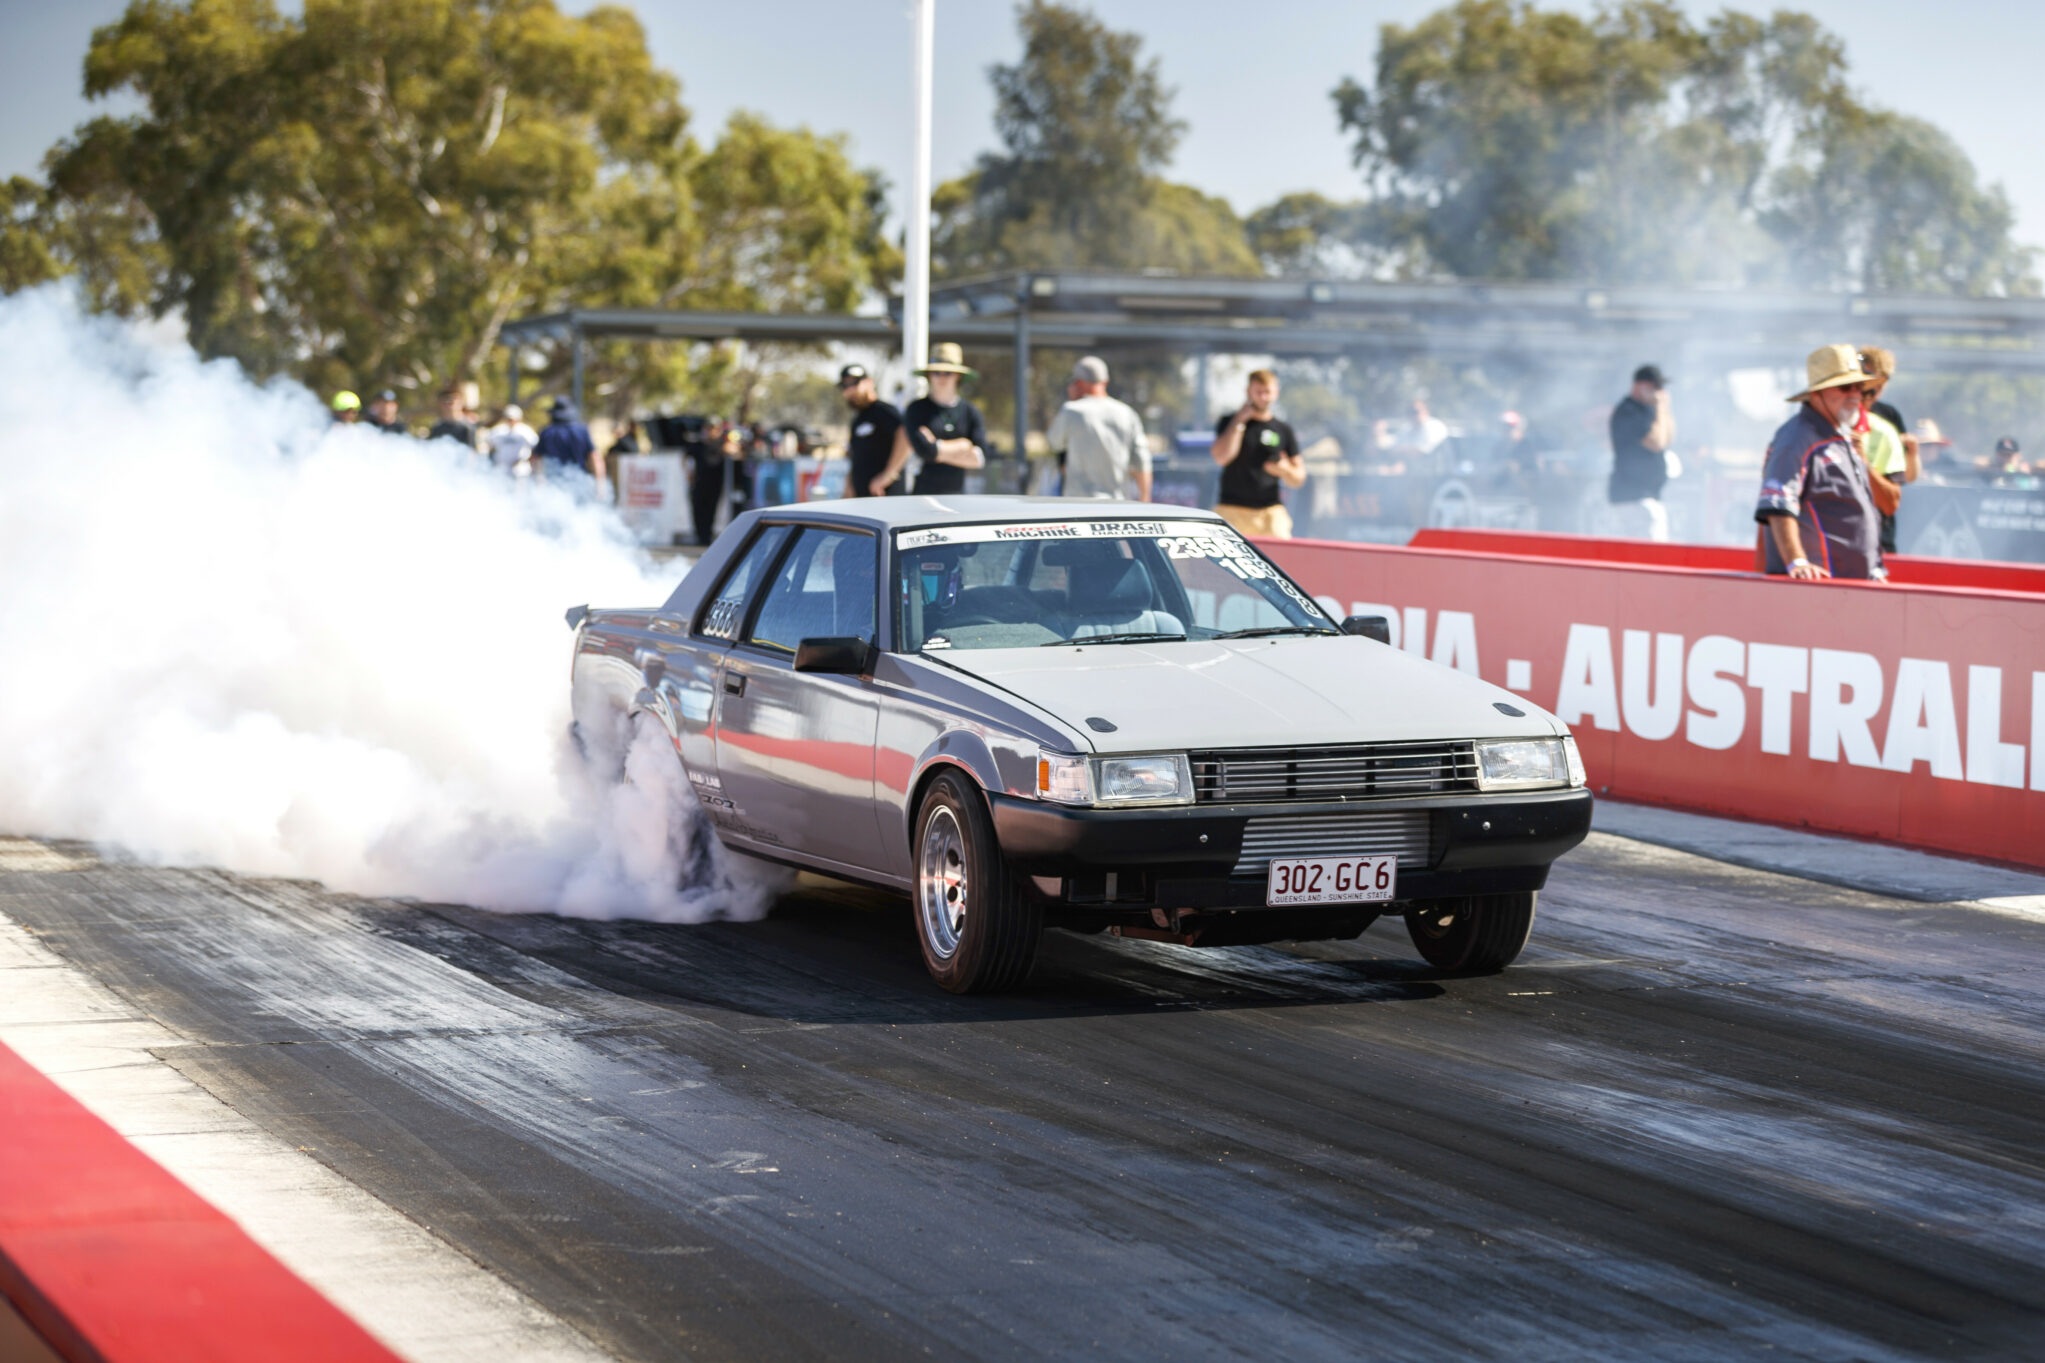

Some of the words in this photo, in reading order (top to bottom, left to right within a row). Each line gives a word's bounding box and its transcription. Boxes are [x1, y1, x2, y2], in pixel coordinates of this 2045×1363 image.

[994, 527, 1081, 539] MACHINE
[1089, 523, 1154, 531] DRAG
[1217, 557, 1267, 580] 16
[1274, 894, 1321, 903] QUEENSLAND
[1328, 893, 1363, 901] SUNSHINE
[1367, 891, 1389, 899] STATE
